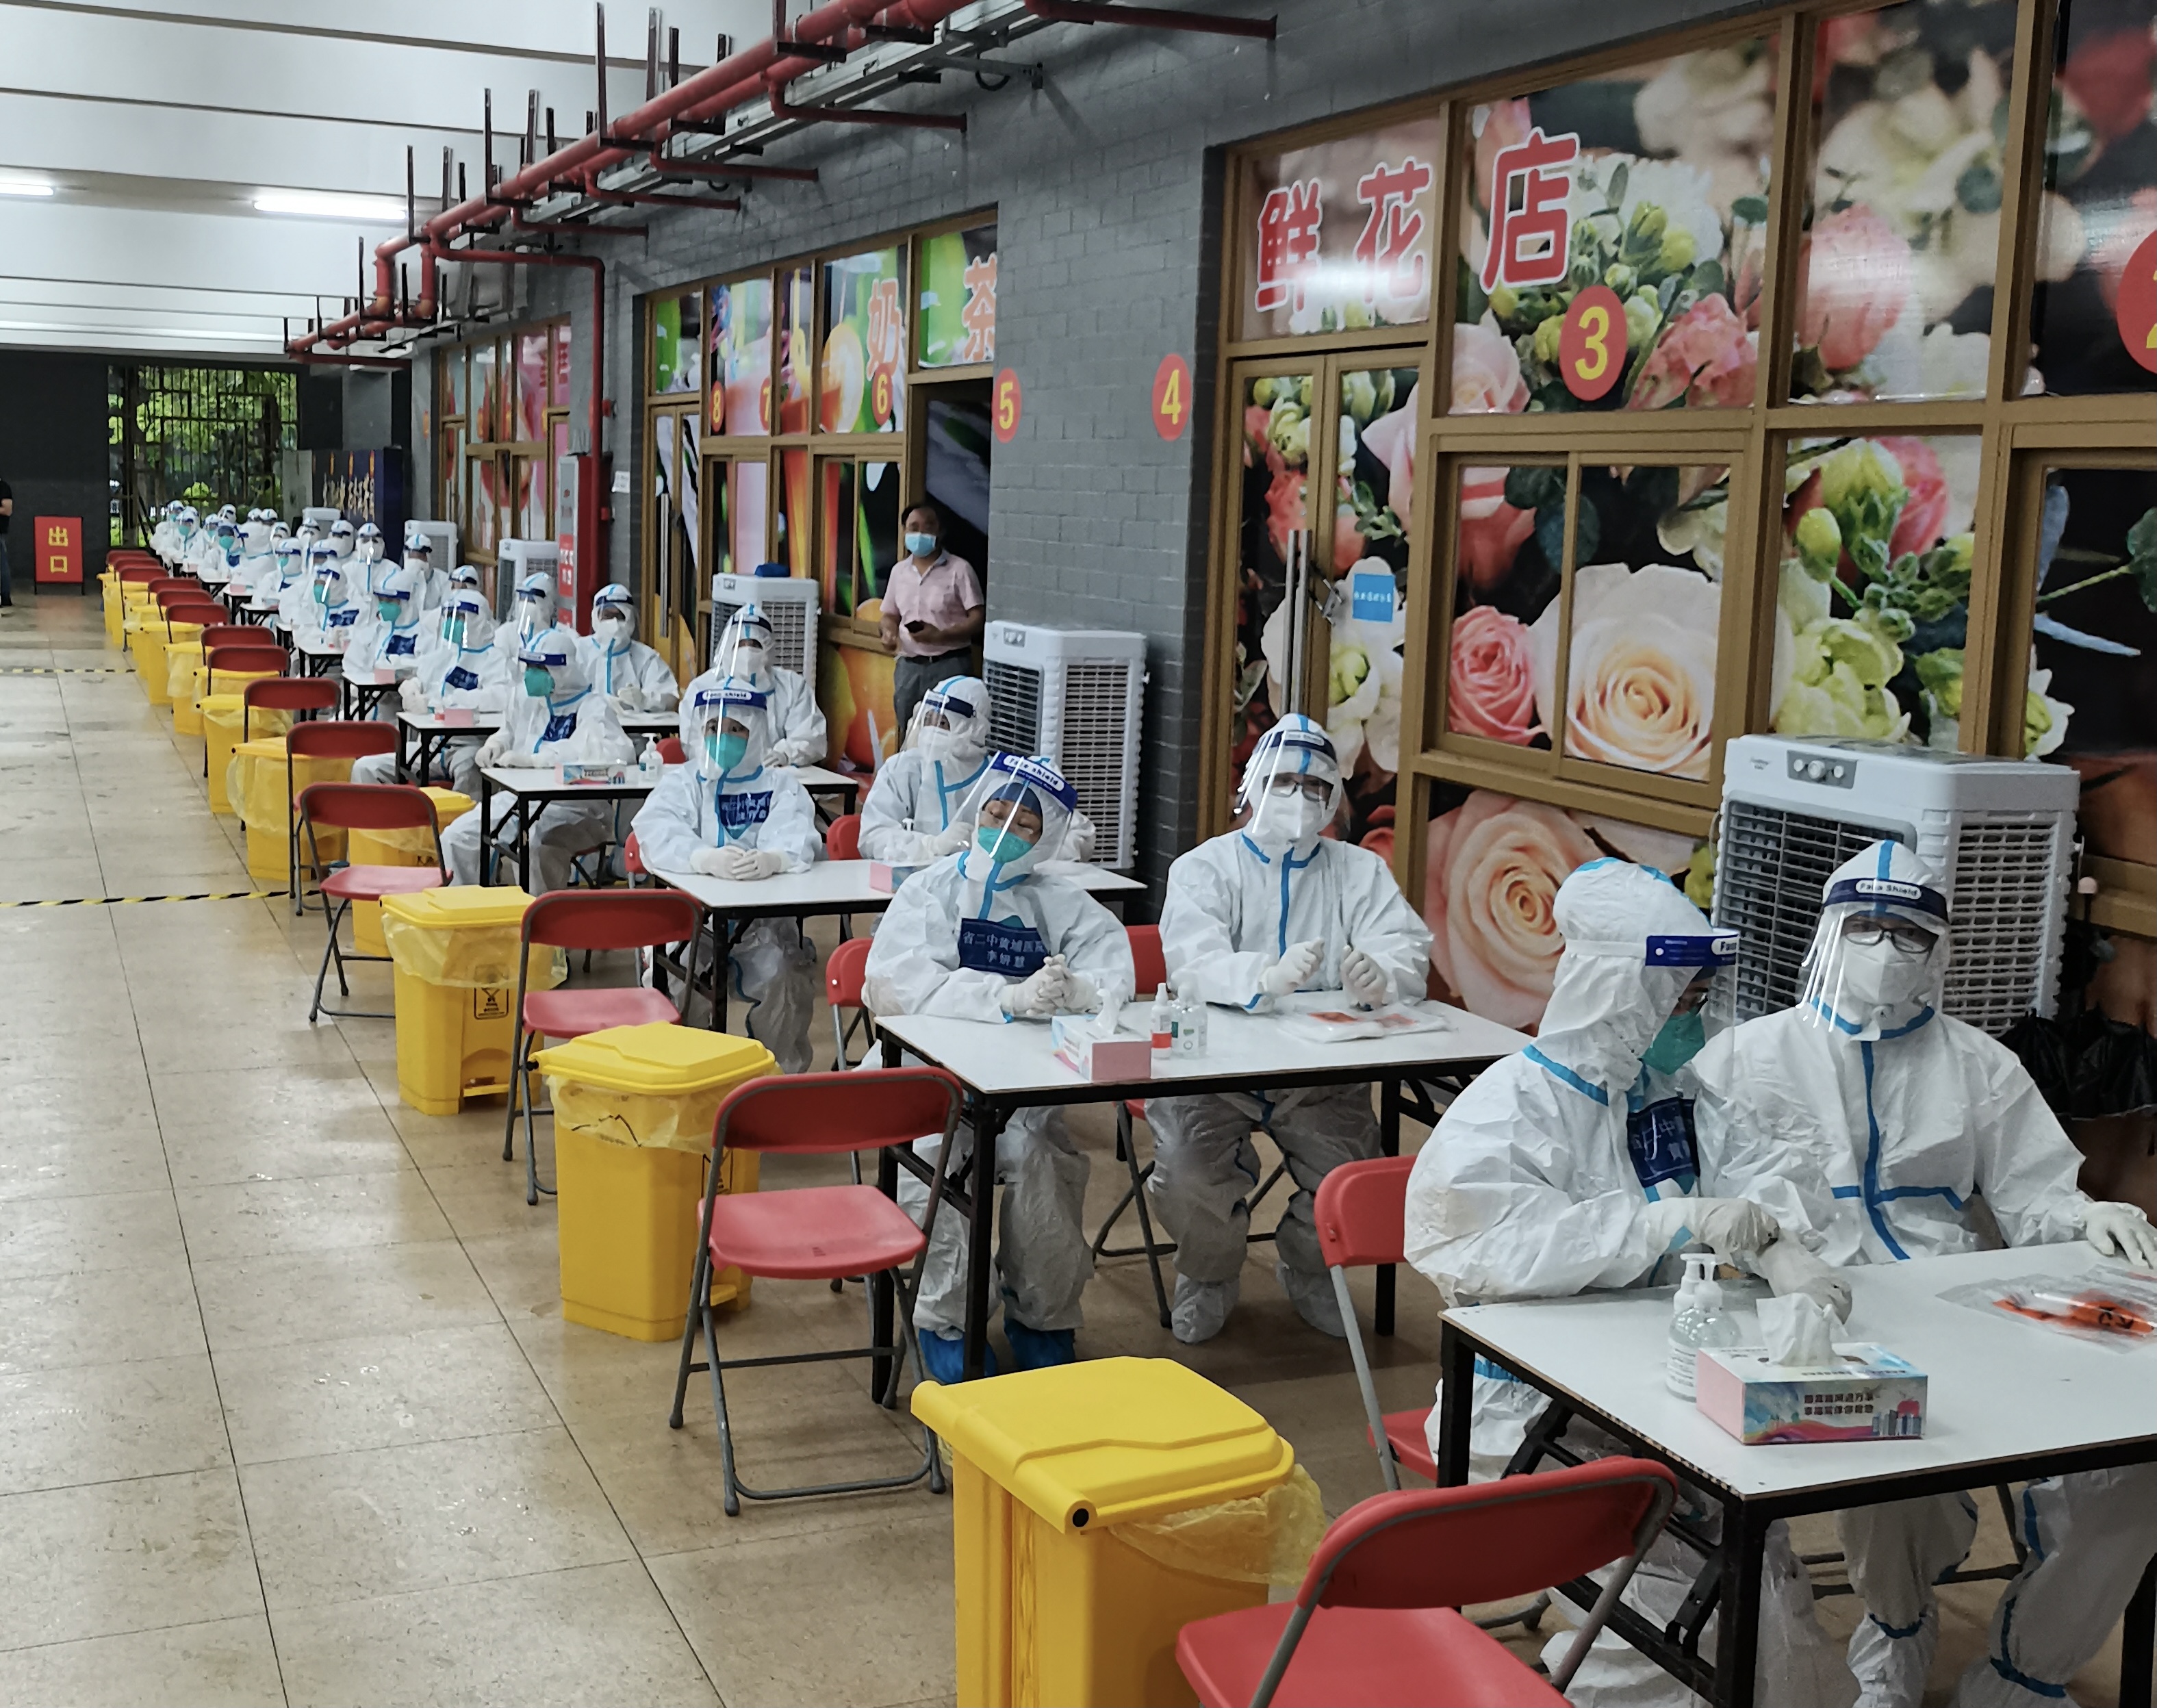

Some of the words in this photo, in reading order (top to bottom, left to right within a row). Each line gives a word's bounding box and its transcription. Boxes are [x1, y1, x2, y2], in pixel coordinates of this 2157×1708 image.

[1255, 127, 1580, 312] 鲜花店
[867, 253, 997, 381] 奶茶
[1575, 306, 1609, 380] 3
[713, 390, 721, 423] 8
[876, 374, 889, 415] 6
[999, 381, 1014, 430] 5
[1161, 369, 1182, 425] 4
[48, 526, 68, 573] 出口
